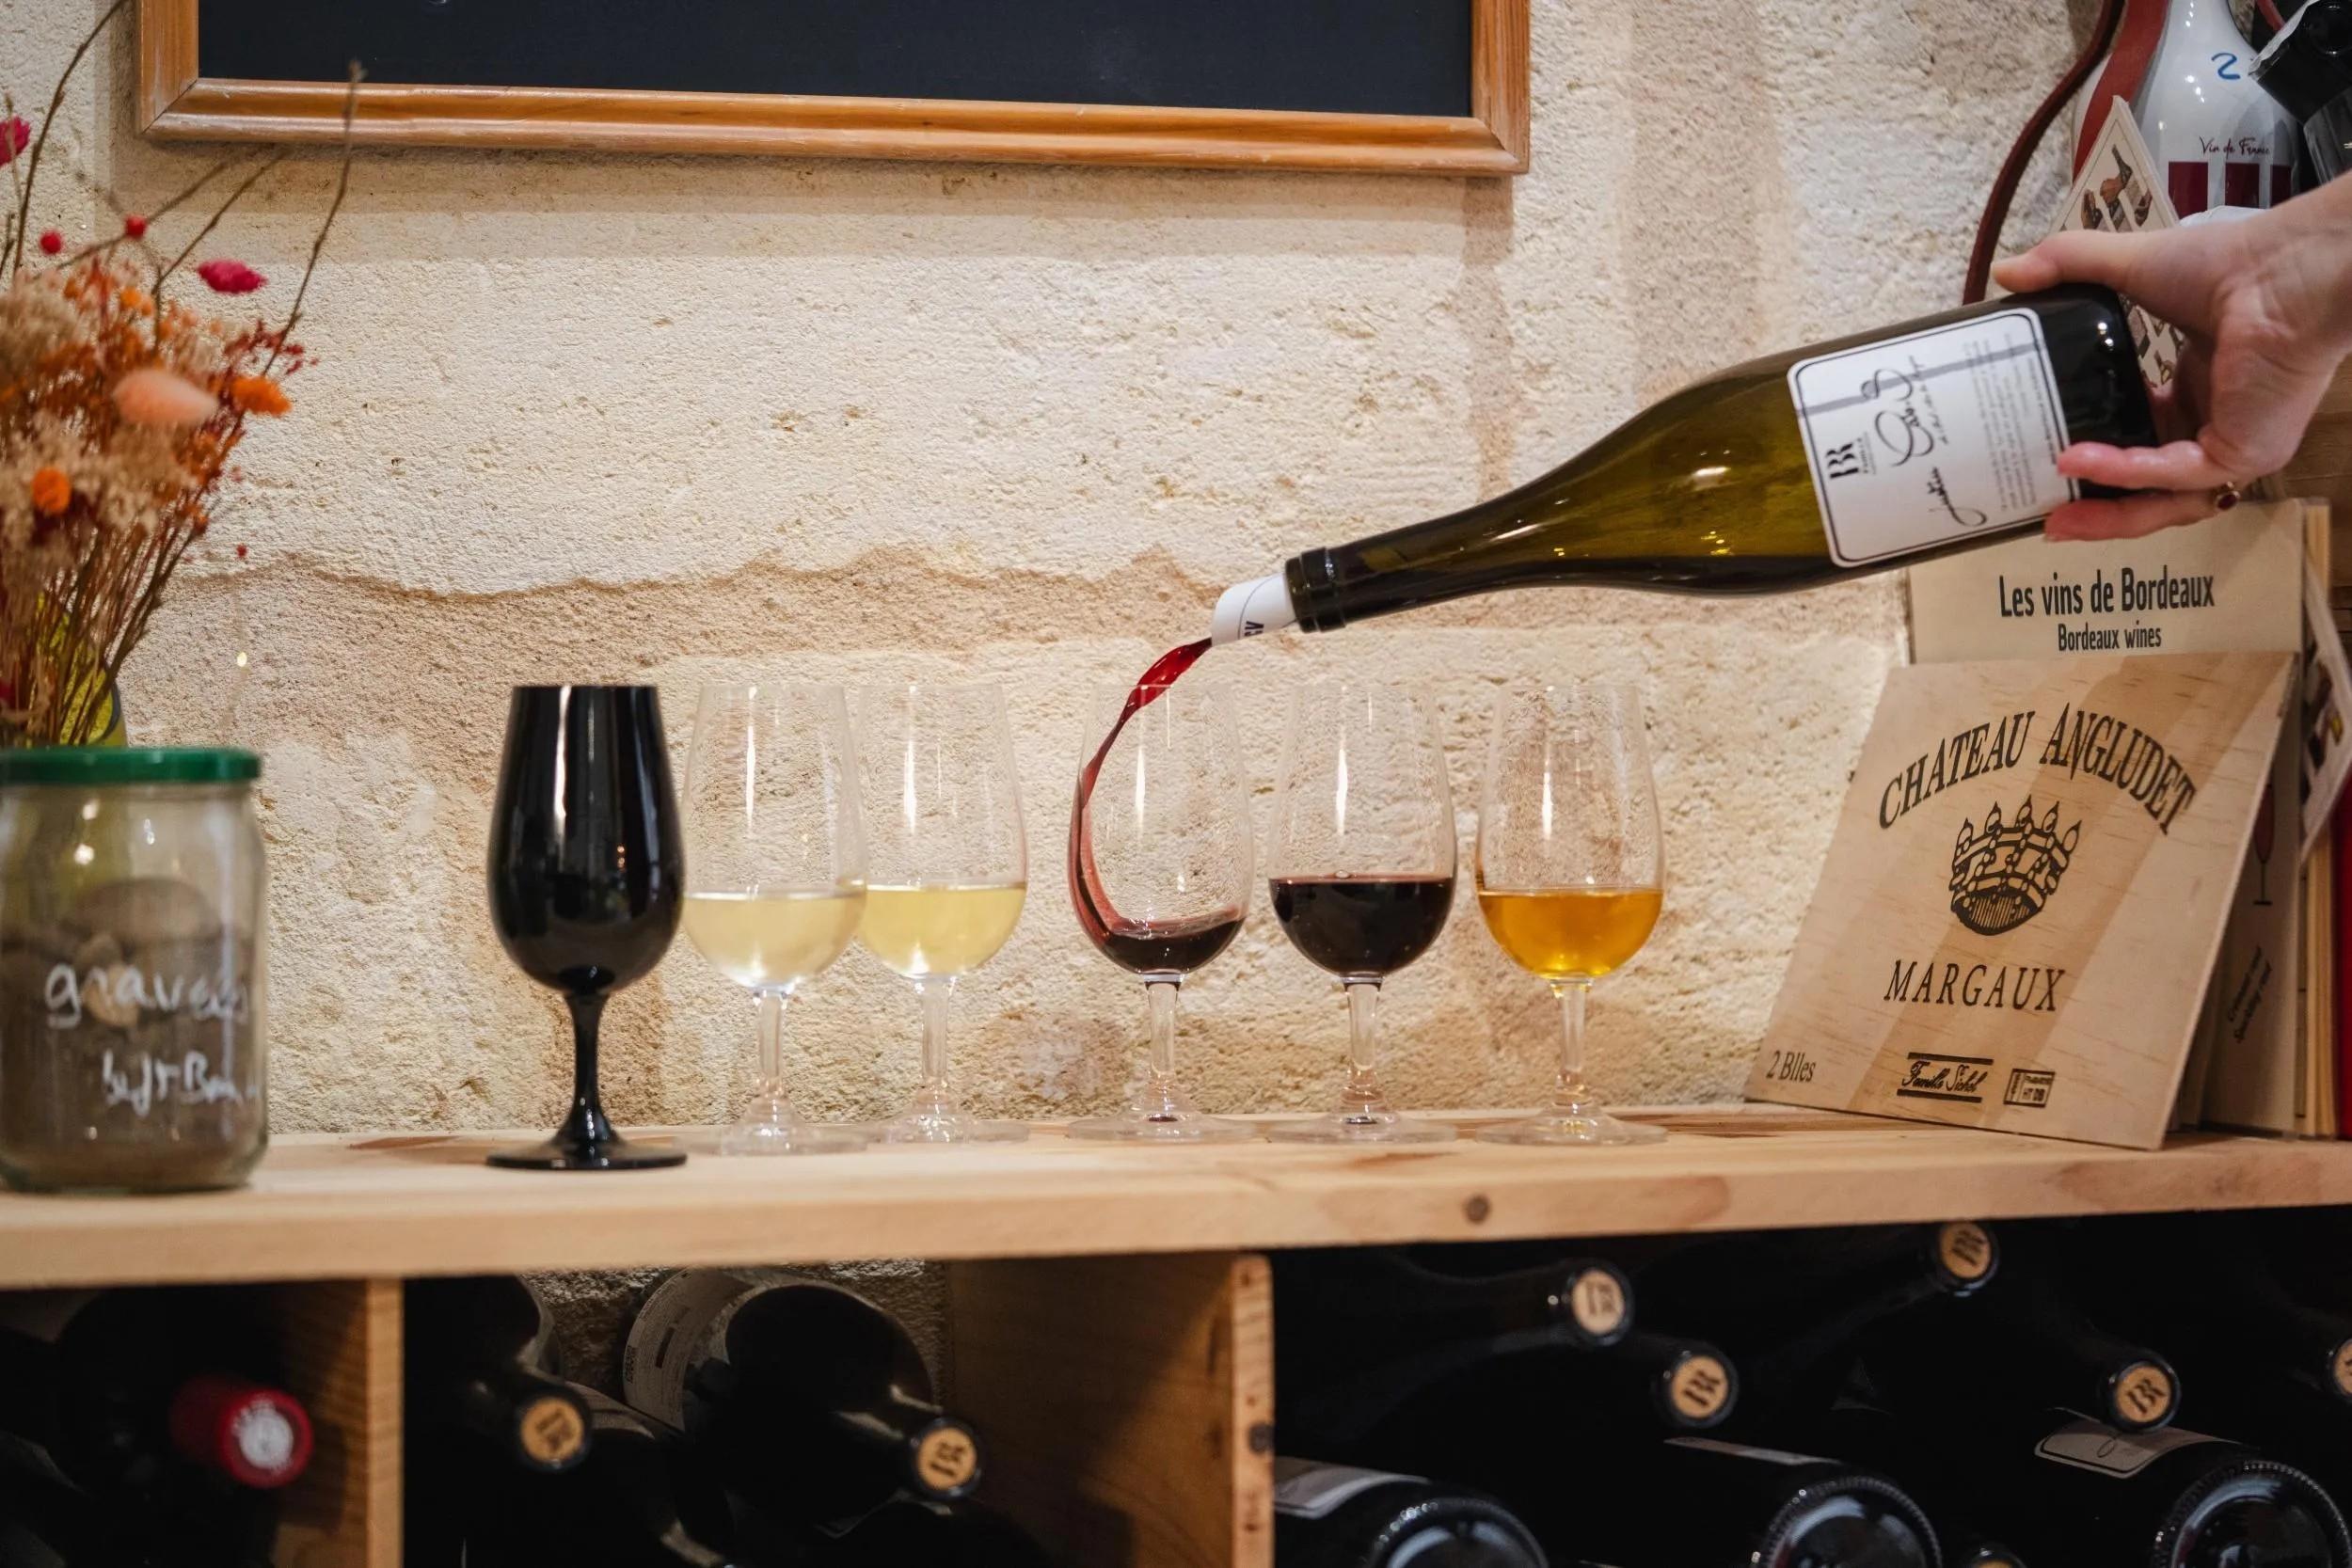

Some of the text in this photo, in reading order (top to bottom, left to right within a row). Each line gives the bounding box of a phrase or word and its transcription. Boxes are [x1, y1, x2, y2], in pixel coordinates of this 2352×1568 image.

[2210, 52, 2242, 81] 2
[2199, 135, 2270, 161] Vin de France
[1998, 564, 2216, 618] Les vins de Bordeaux
[2058, 620, 2163, 652] Bordeaux wines
[1879, 702, 2198, 836] CHATEAU ANGLUDET
[1883, 959, 2066, 1012] MARGAUX
[1765, 1050, 1817, 1083] 2 Blles
